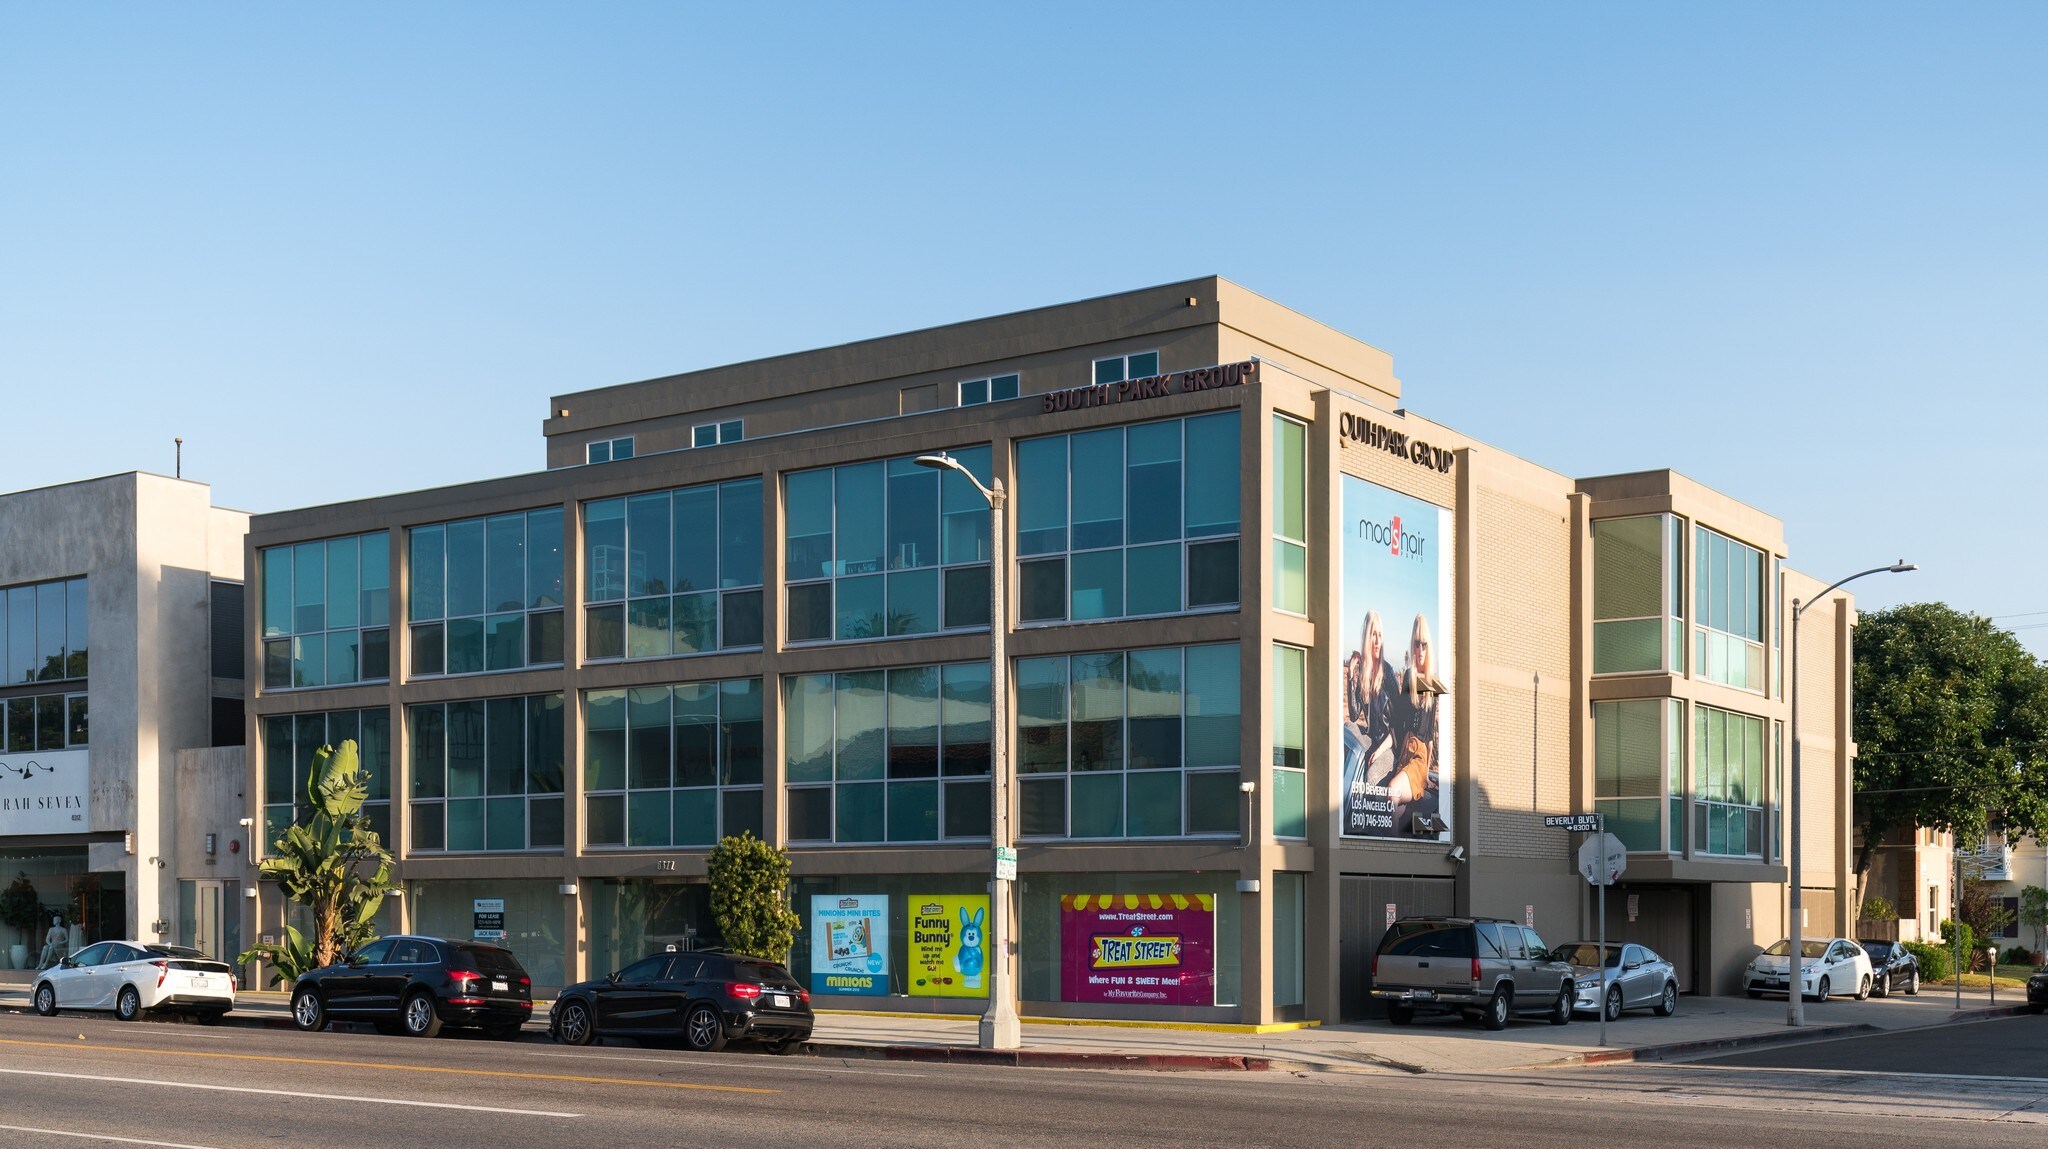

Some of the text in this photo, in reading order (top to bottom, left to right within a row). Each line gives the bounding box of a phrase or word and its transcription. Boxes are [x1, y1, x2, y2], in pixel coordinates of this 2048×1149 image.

[1043, 361, 1255, 413] SOUTH PARK GROUP
[1340, 411, 1454, 474] OUTH PARK GROUP
[1351, 781, 1365, 795] 8310
[1365, 782, 1388, 797] BEVERLY
[38, 795, 82, 810] SEVEN
[1362, 798, 1386, 812] ANGELES
[1386, 800, 1396, 813] CA
[1351, 811, 1393, 829] (310) 746-5986
[1546, 816, 1575, 826] BEVERLY
[1099, 912, 1173, 921] www.TreatStreet.com
[914, 916, 950, 934] Funny
[1101, 938, 1172, 963] TREAT STREET
[1088, 975, 1181, 986] Where FUN & SWEET Meet!
